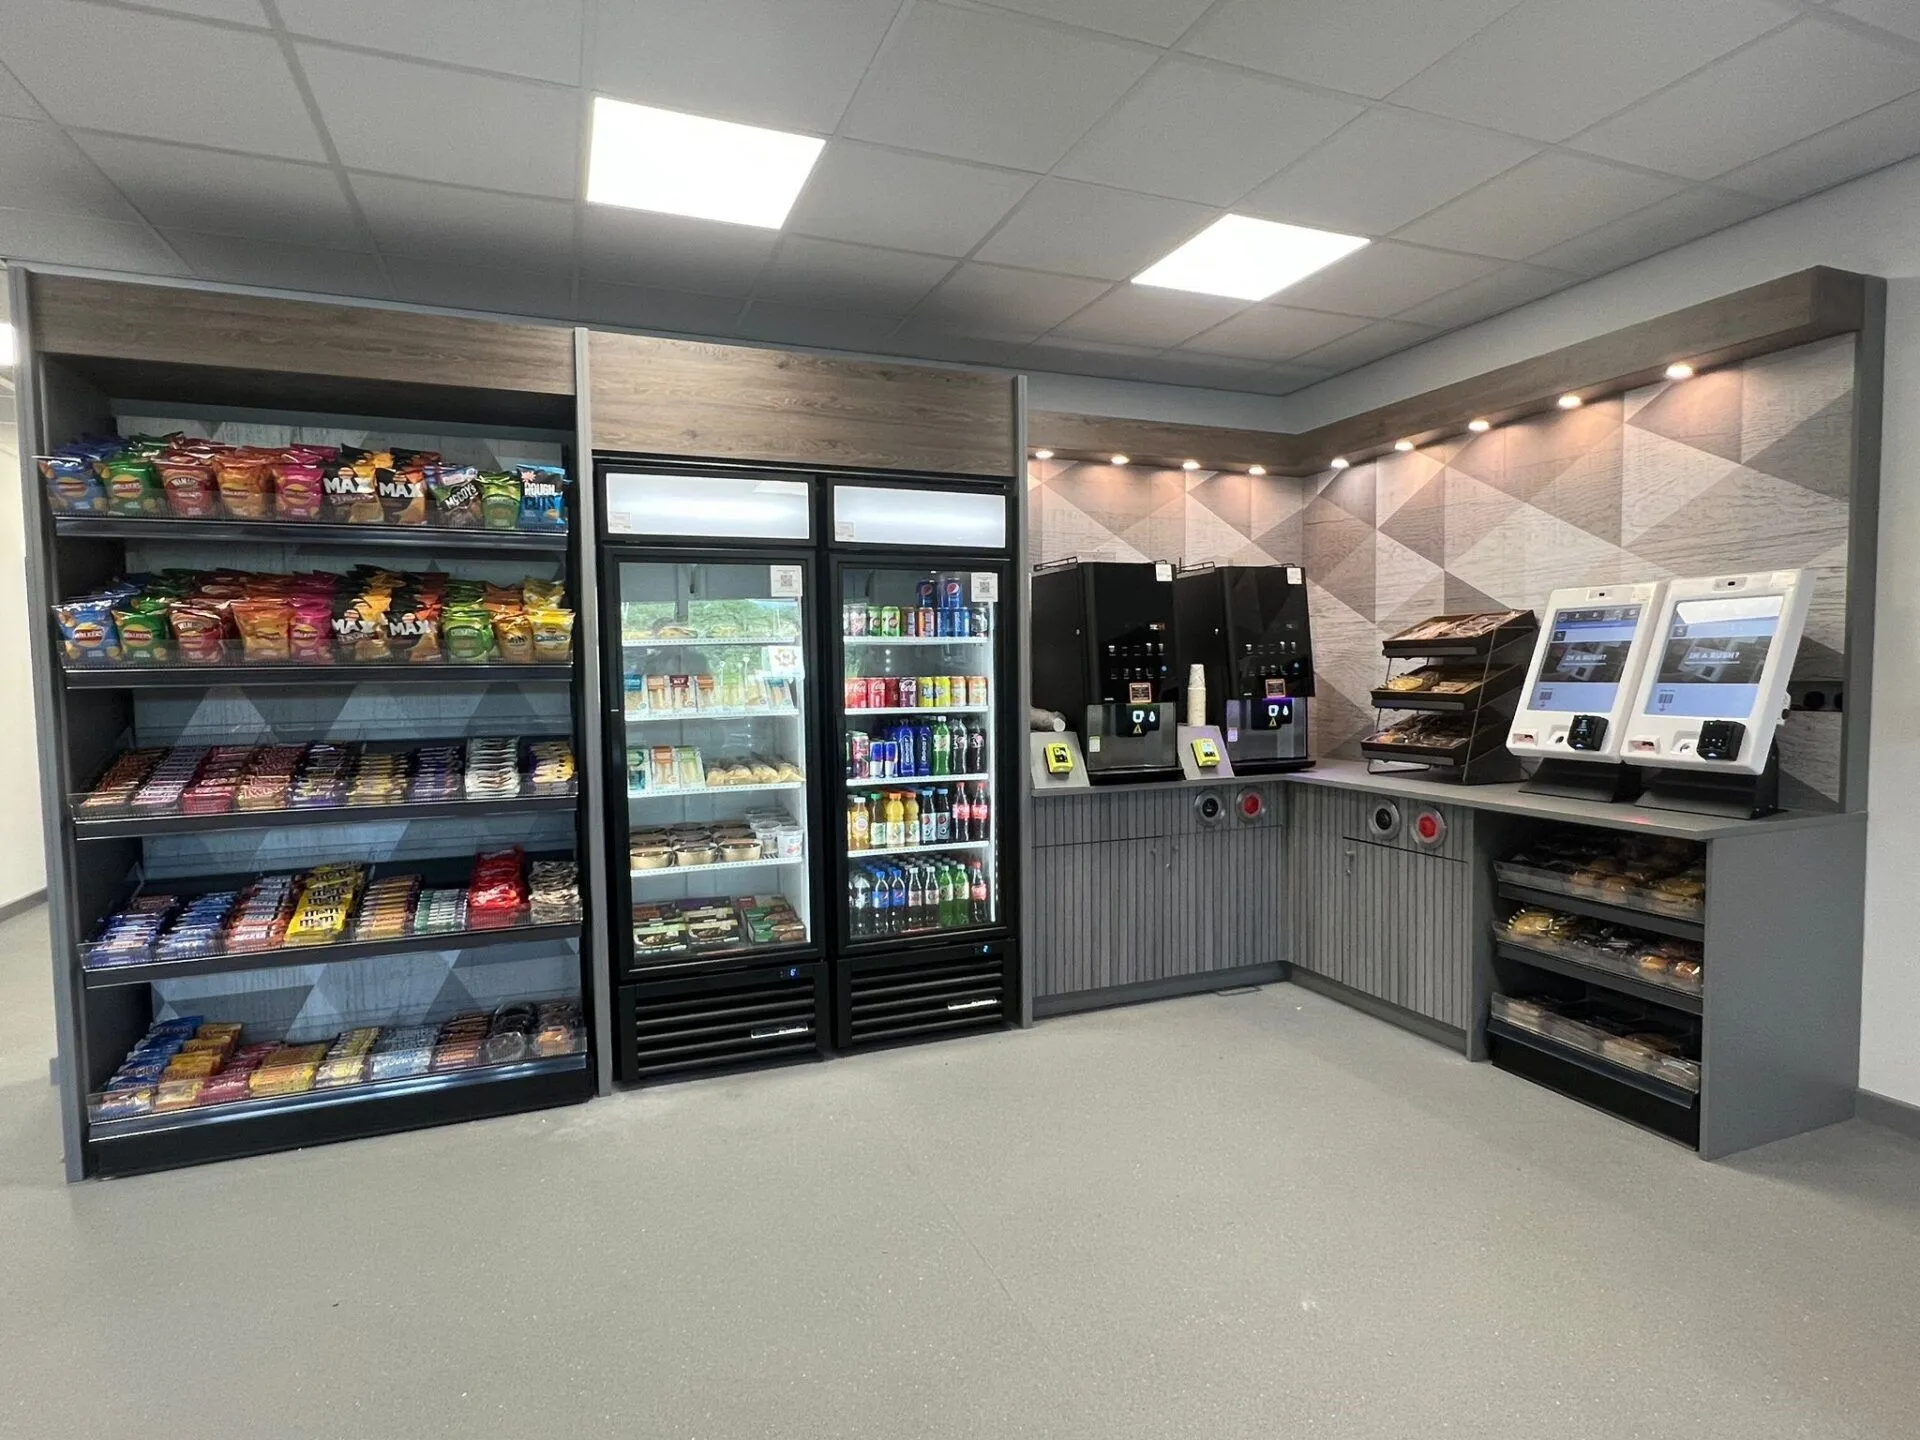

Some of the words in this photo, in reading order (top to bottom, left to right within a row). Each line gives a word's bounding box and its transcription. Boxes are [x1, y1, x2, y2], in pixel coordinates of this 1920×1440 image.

[323, 478, 375, 494] MAX
[380, 482, 425, 498] MAX
[332, 619, 375, 635] MAX
[389, 620, 432, 636] MAX
